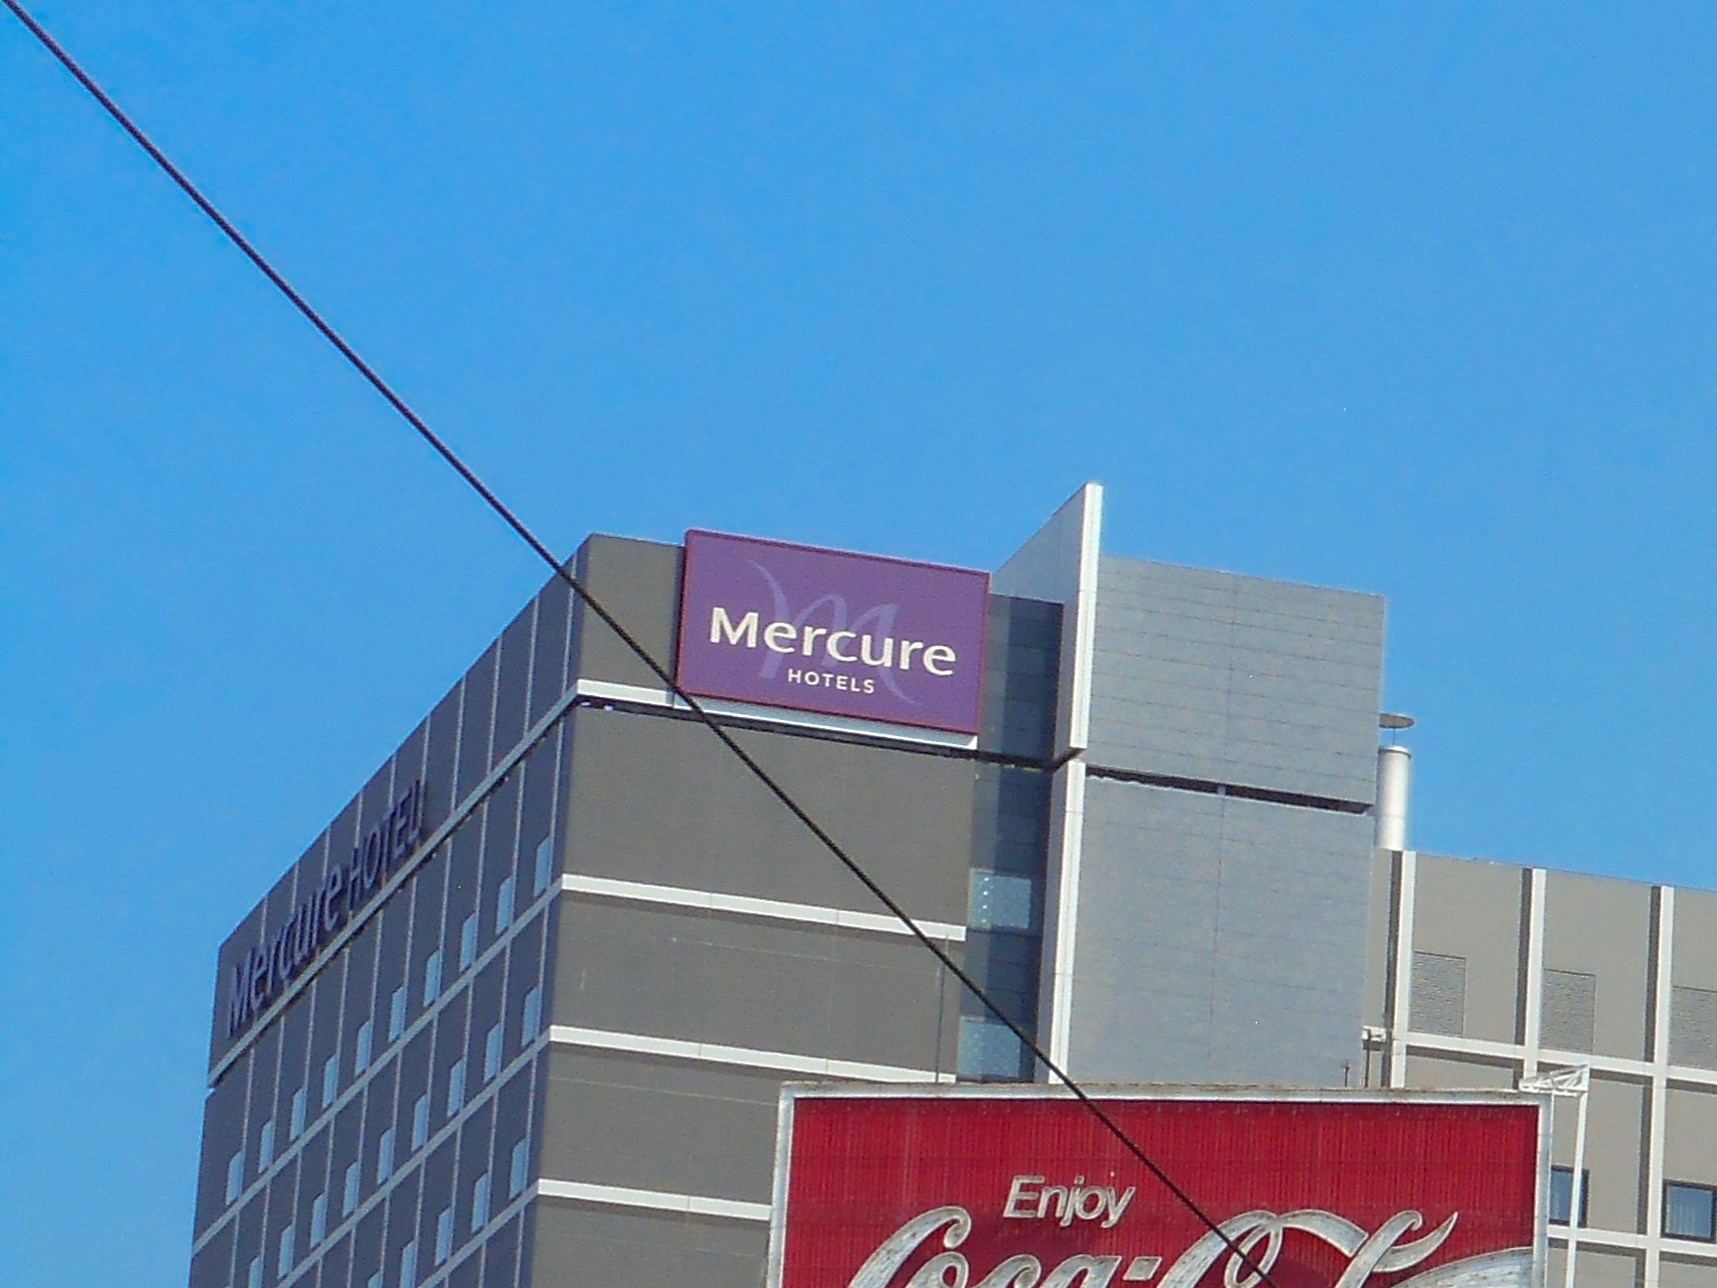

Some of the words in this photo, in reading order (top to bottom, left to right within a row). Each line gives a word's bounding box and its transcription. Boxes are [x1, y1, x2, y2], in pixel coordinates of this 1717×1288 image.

[709, 606, 957, 678] Mercure
[787, 668, 875, 695] HOTELS
[226, 862, 344, 1042] Mercure
[350, 779, 422, 904] HOTEL
[1002, 1175, 1136, 1228] Enjoy
